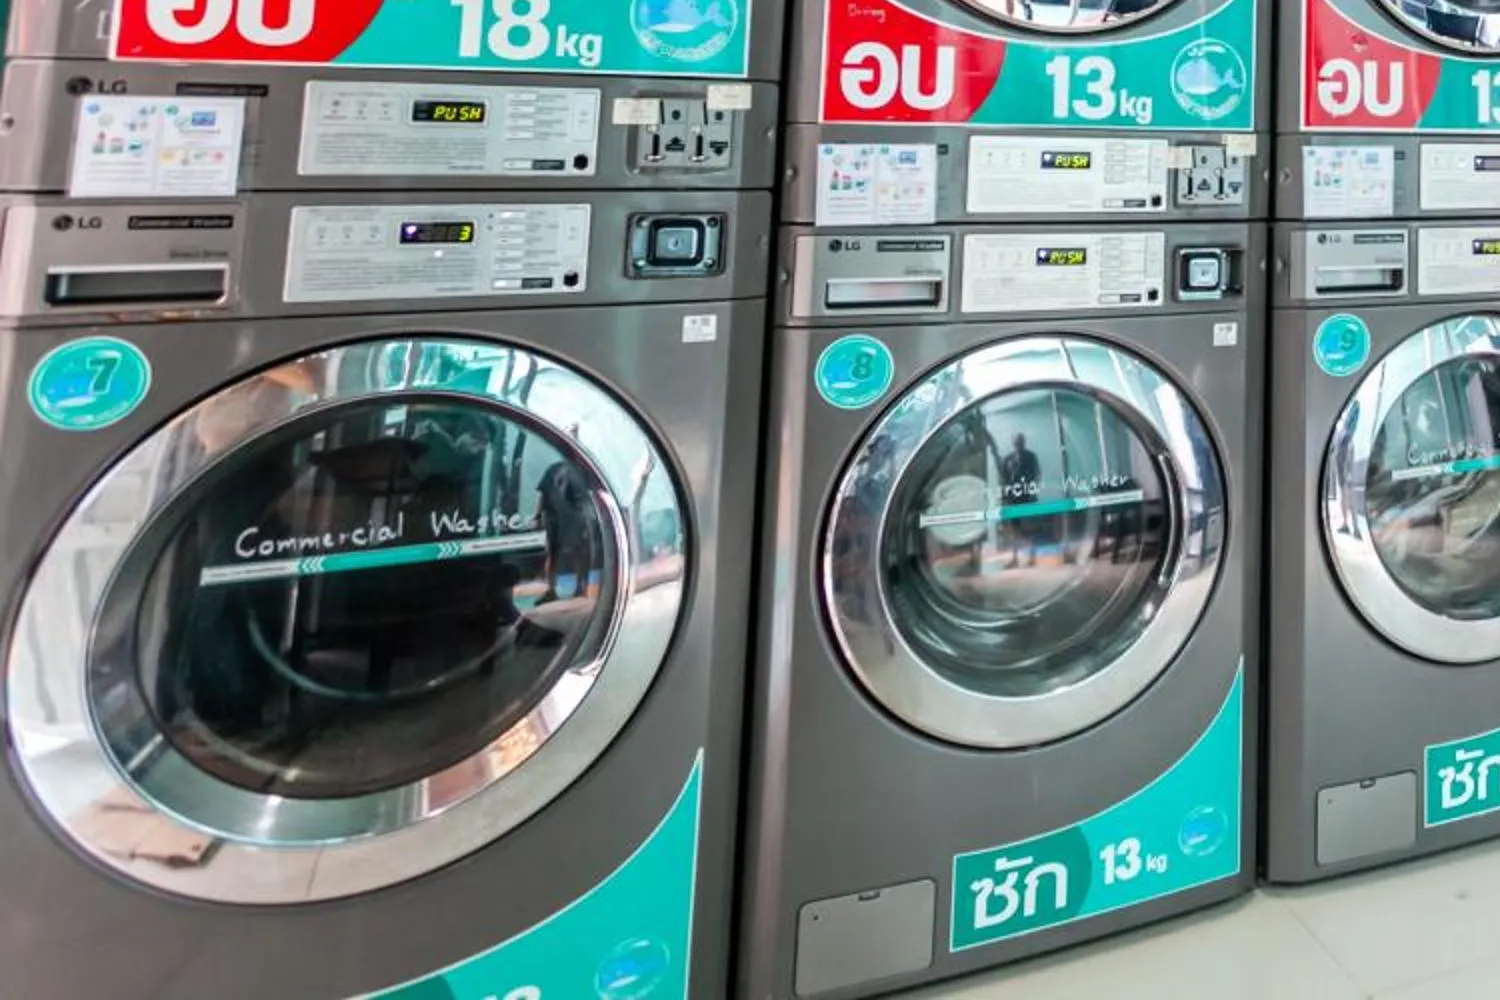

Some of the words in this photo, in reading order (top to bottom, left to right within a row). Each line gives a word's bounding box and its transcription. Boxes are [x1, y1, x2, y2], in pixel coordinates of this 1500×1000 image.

[556, 24, 603, 67] kg
[98, 80, 127, 95] LG
[840, 41, 956, 111] อบ
[1046, 55, 1116, 119] 13
[1119, 87, 1153, 125] kg
[1318, 58, 1404, 118] อบ
[432, 105, 482, 121] PUSH
[1055, 154, 1090, 168] PUSH
[78, 216, 103, 229] LG
[458, 225, 472, 240] 3
[844, 241, 862, 251] LG
[1049, 251, 1085, 265] PUSH
[1339, 329, 1356, 356] 9
[85, 350, 123, 393] 7
[850, 352, 873, 381] 8
[235, 511, 405, 559] Commercial
[1099, 838, 1142, 886] 13
[1146, 852, 1168, 875] kg
[969, 854, 1067, 930] ซัก
